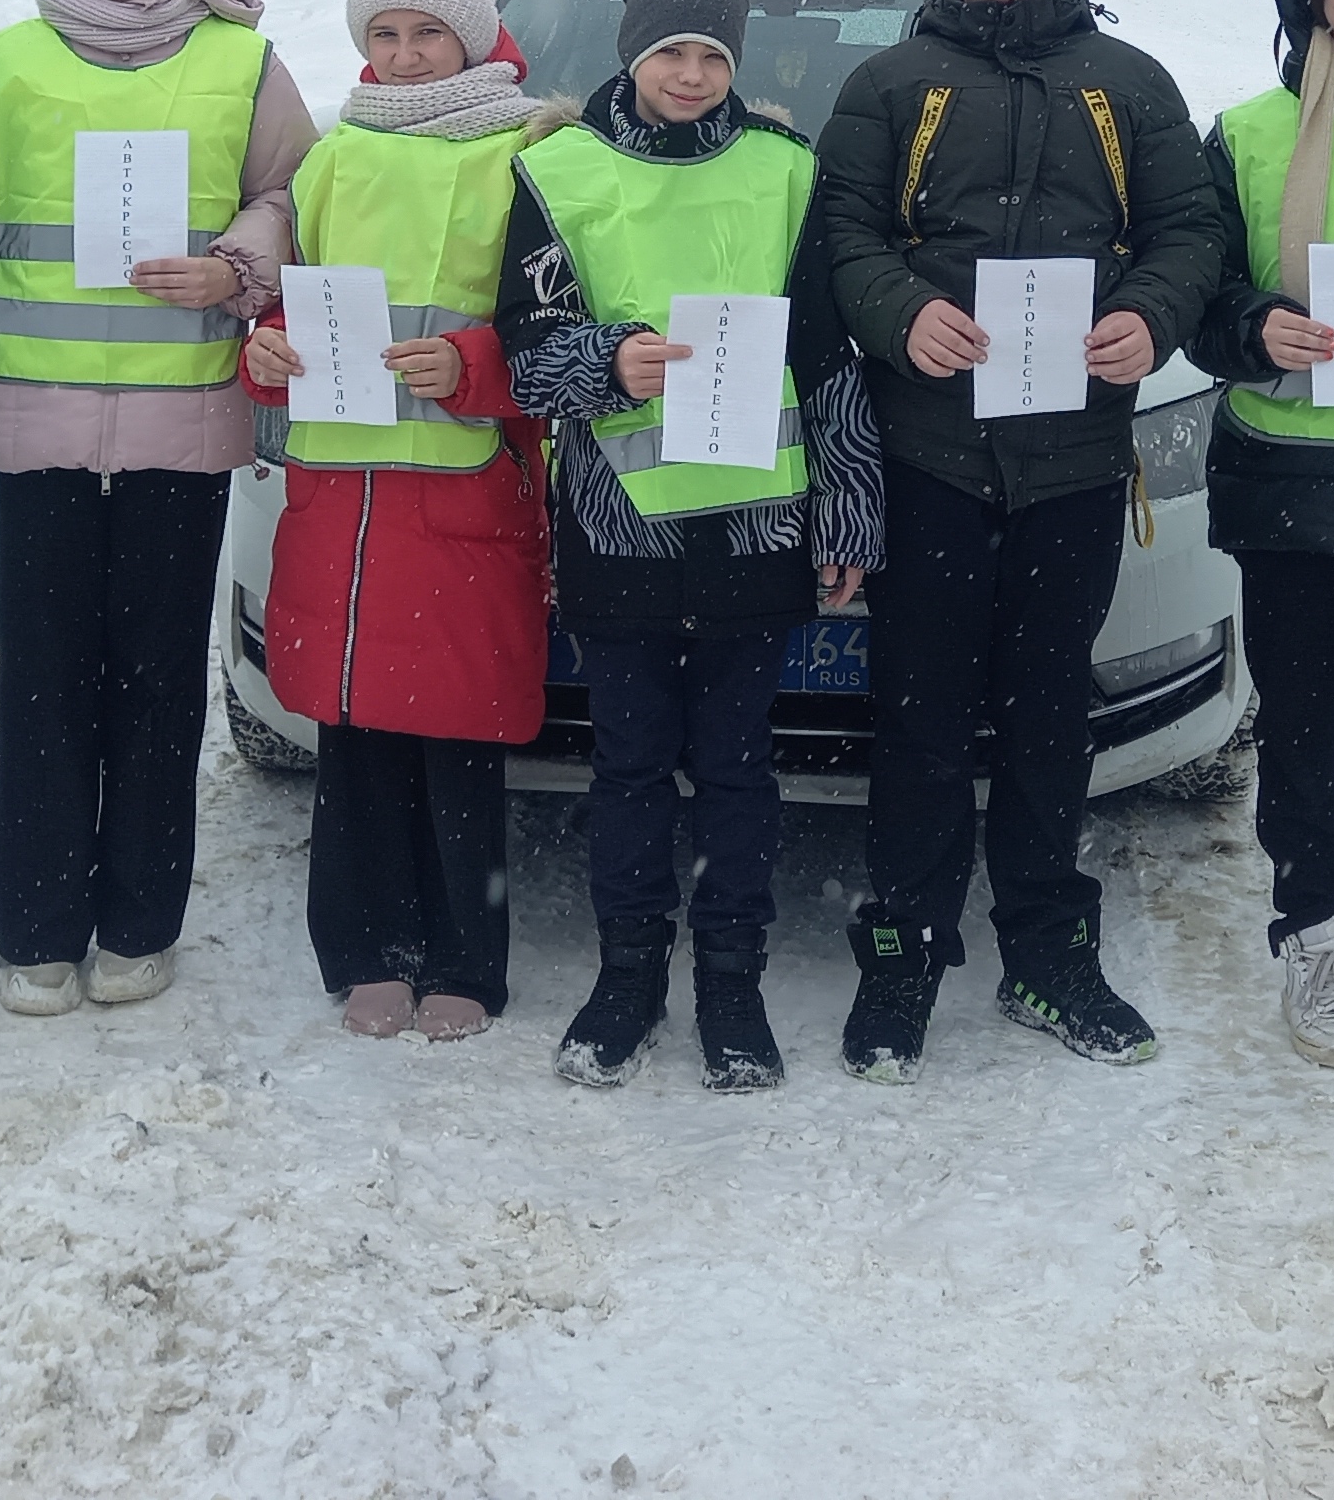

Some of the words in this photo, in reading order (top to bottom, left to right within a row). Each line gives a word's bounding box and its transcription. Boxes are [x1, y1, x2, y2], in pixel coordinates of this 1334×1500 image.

[122, 139, 134, 280] АВТОКРЕСЛО
[322, 278, 346, 415] АВТОКРЕСЛО
[709, 301, 731, 454] АВТОКРЕСЛО
[1022, 269, 1036, 407] АВТОКРЕСЛО
[813, 626, 867, 668] 64
[819, 671, 860, 686] RUS
